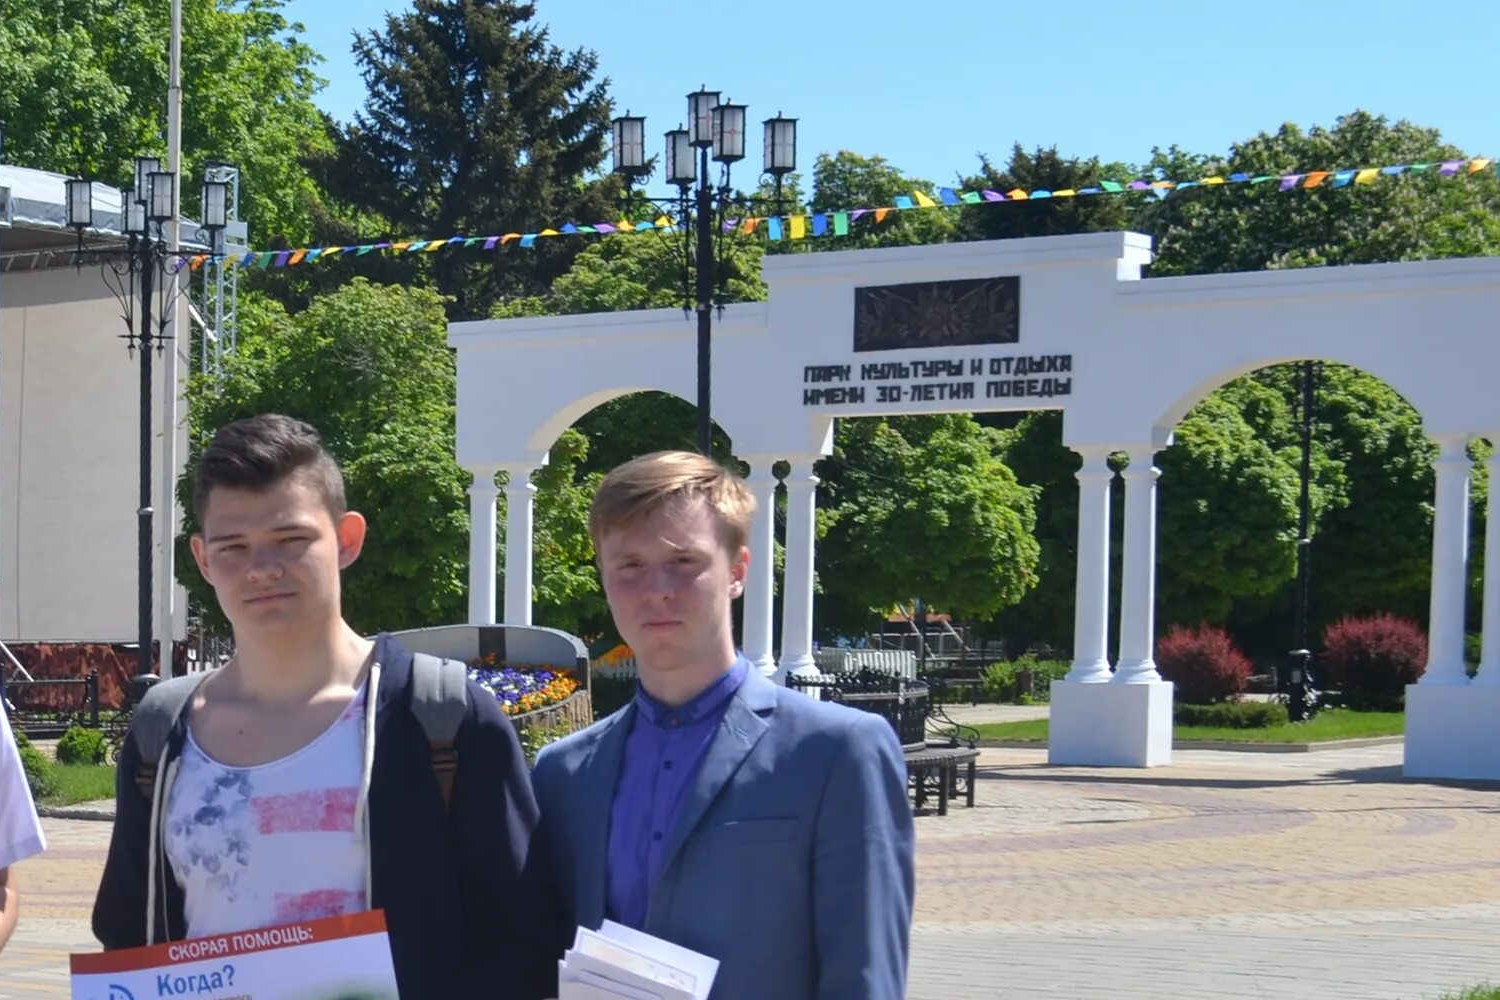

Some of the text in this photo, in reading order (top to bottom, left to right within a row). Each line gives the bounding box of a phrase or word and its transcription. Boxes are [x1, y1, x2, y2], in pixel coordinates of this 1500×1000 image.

[803, 354, 1072, 383] ПАРК КУЛЬТУРЫ И ОТДЫХА
[803, 377, 1072, 406] ИМЕНИ 30-ЛЕТИЯ ПОБЕДЫ
[168, 926, 314, 962] СКОРАЯ ПОМОЩЬ:
[156, 965, 236, 997] Когда?
